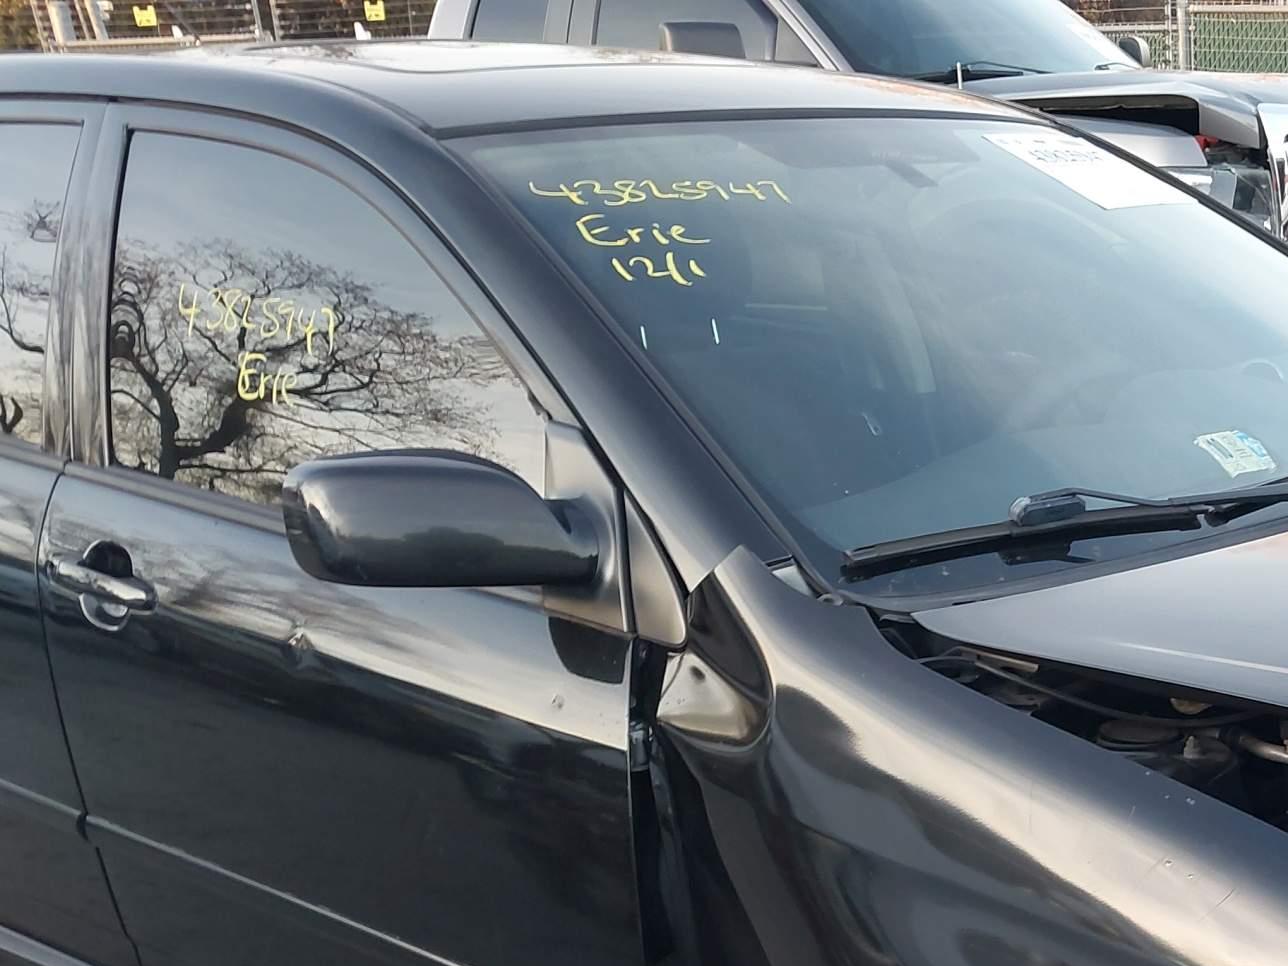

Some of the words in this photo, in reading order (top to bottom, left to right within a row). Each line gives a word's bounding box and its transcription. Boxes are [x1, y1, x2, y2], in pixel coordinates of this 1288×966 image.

[528, 180, 793, 206] 43825947
[576, 213, 712, 247] Erie
[178, 283, 335, 356] 43825947
[237, 352, 298, 408] Erie
